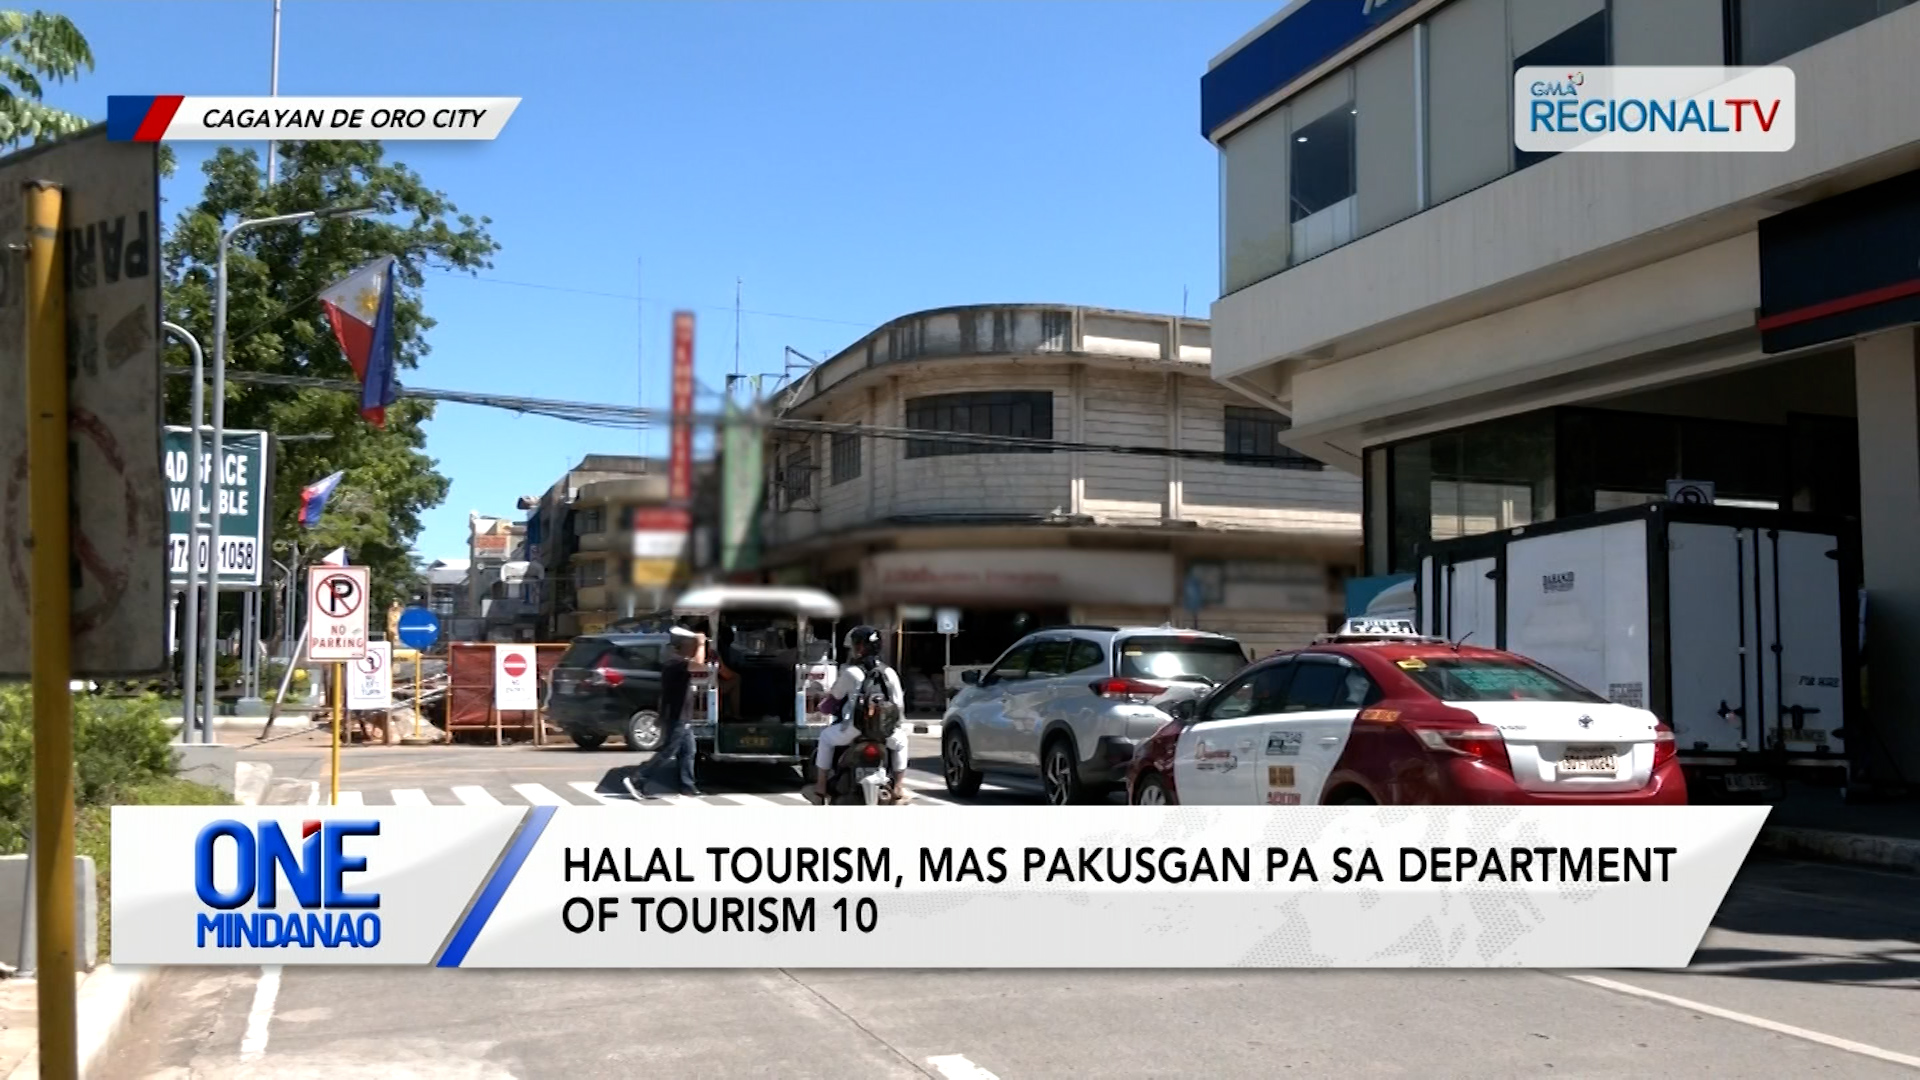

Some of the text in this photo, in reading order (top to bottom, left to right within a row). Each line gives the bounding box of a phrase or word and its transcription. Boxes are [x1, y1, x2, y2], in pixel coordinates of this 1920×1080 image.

[165, 451, 188, 482] AD
[330, 579, 354, 612] P
[331, 625, 347, 634] NO
[312, 637, 364, 648] PARKING
